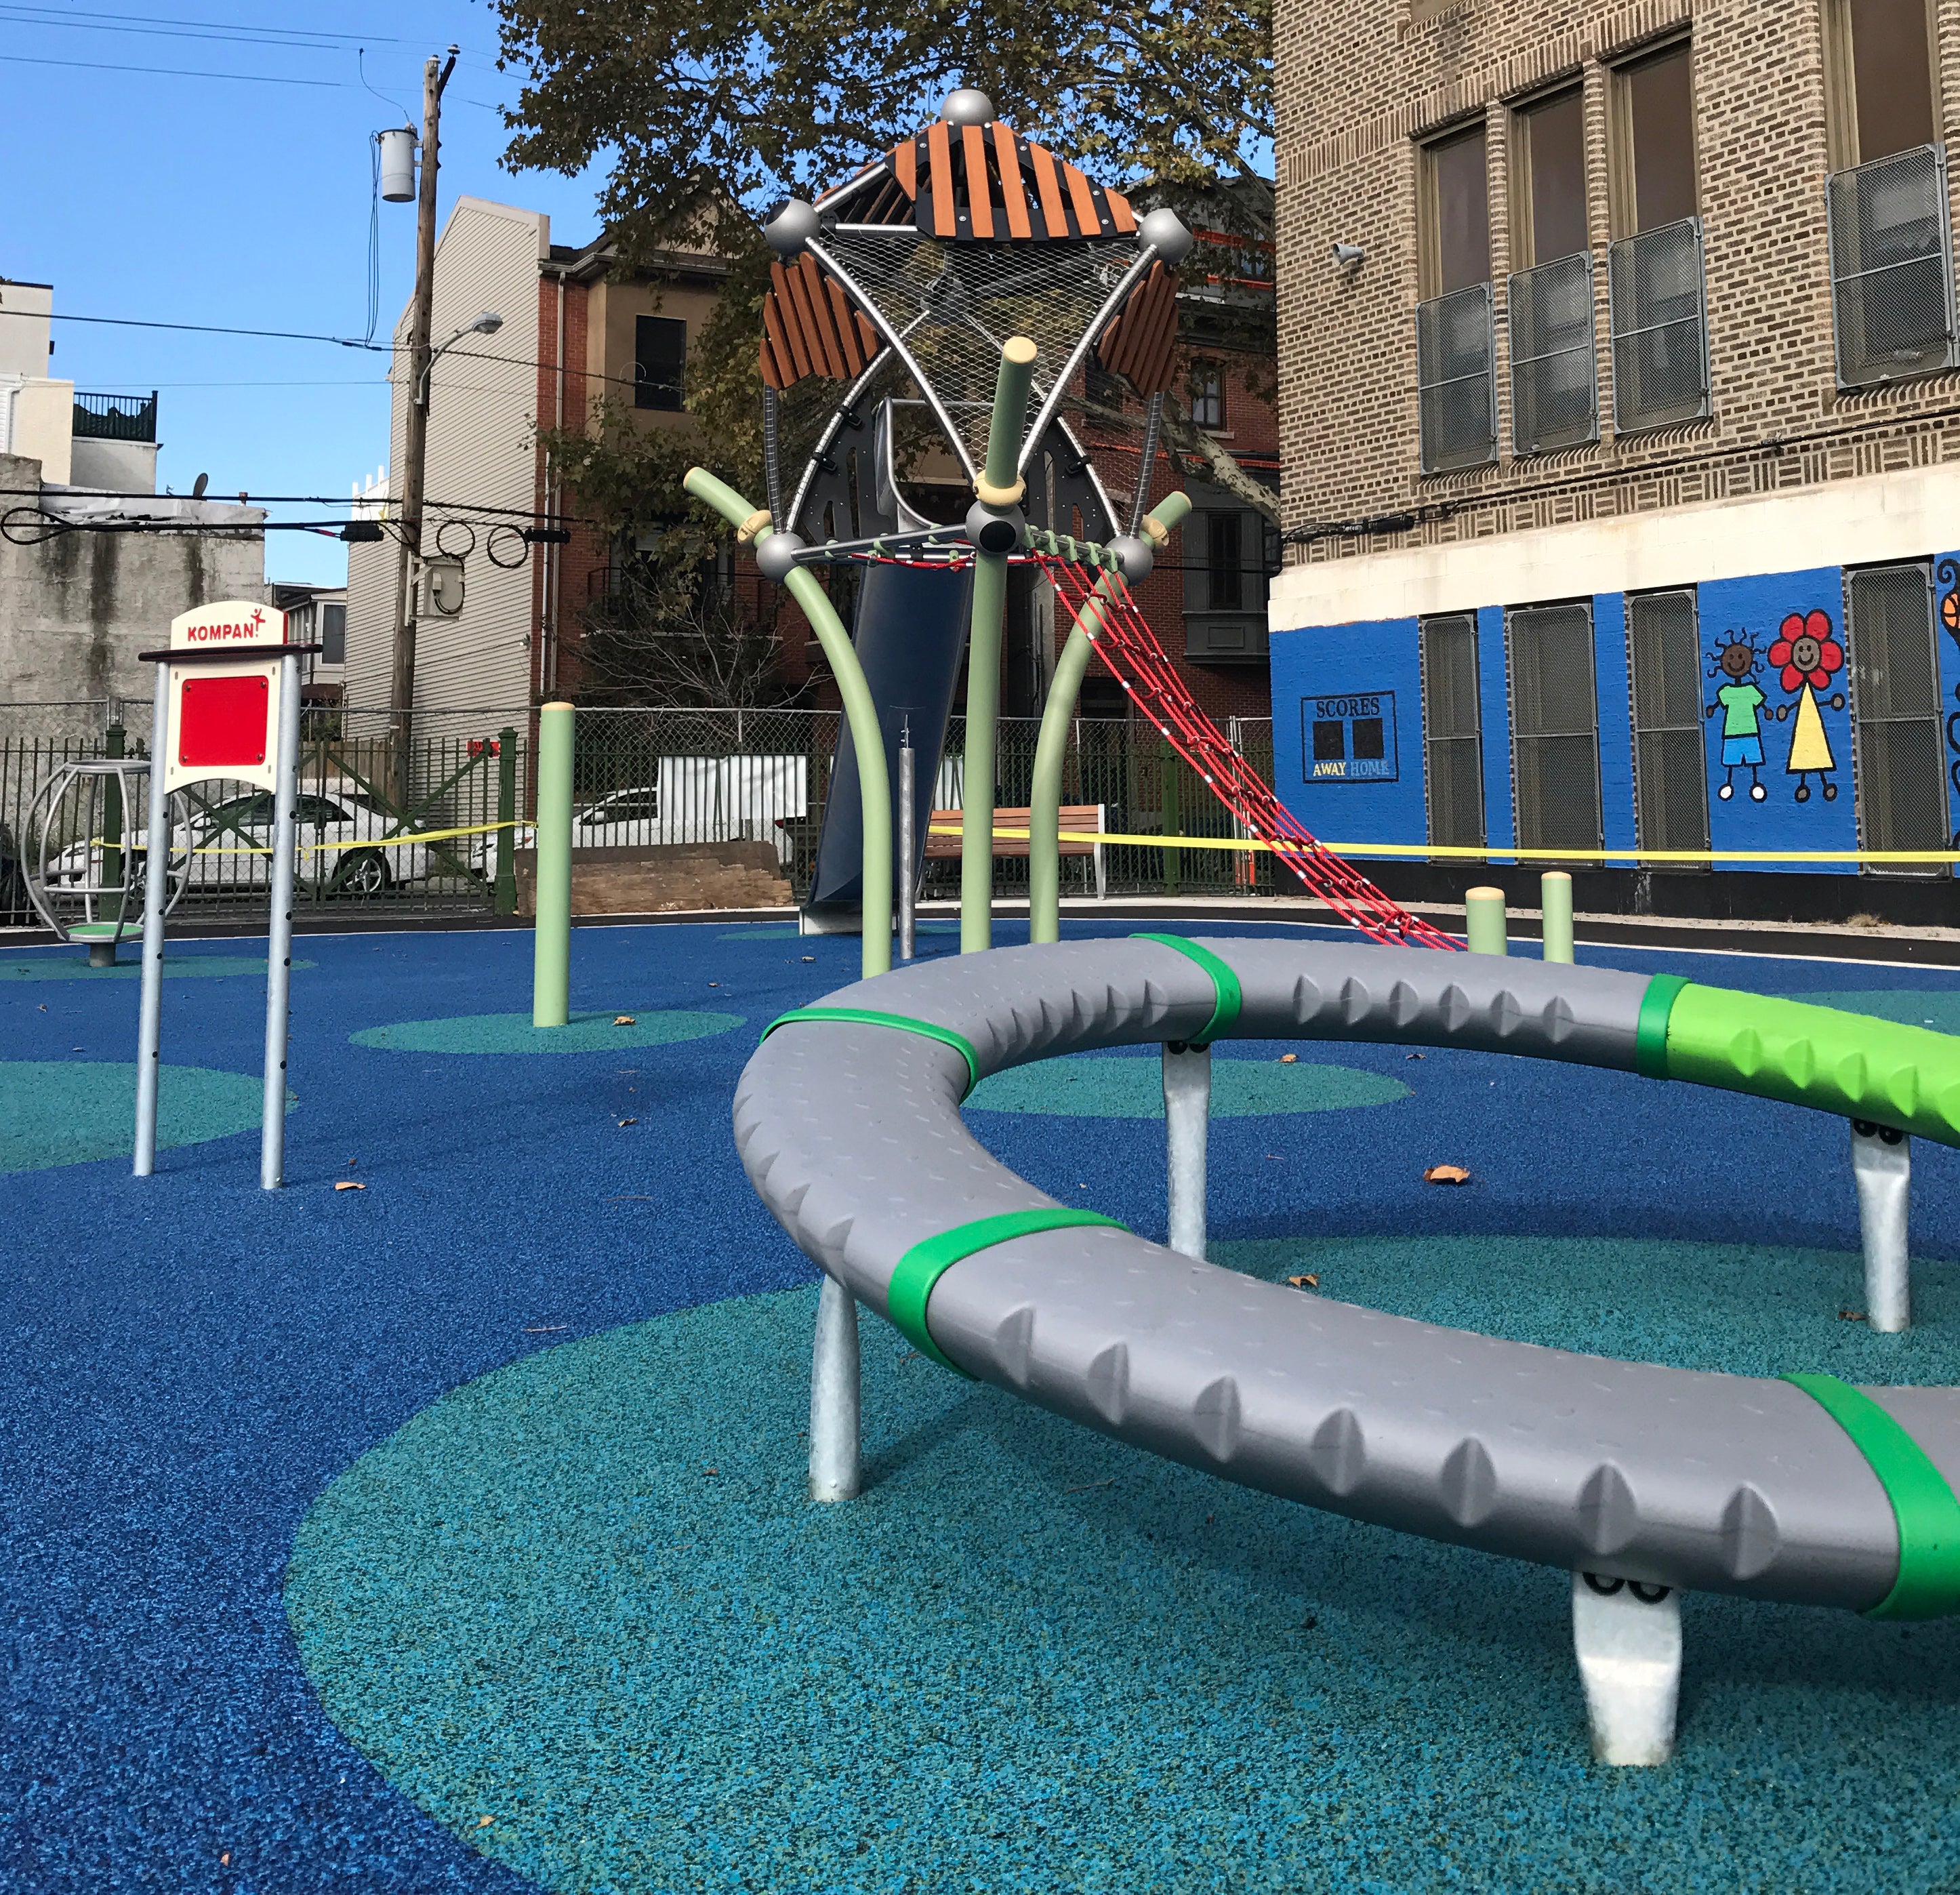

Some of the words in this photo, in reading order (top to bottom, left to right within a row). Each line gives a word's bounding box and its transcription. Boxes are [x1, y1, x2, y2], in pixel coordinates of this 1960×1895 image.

[1316, 697, 1380, 718] SCORES
[1313, 762, 1347, 777] AWAY
[1350, 760, 1389, 777] HOME
